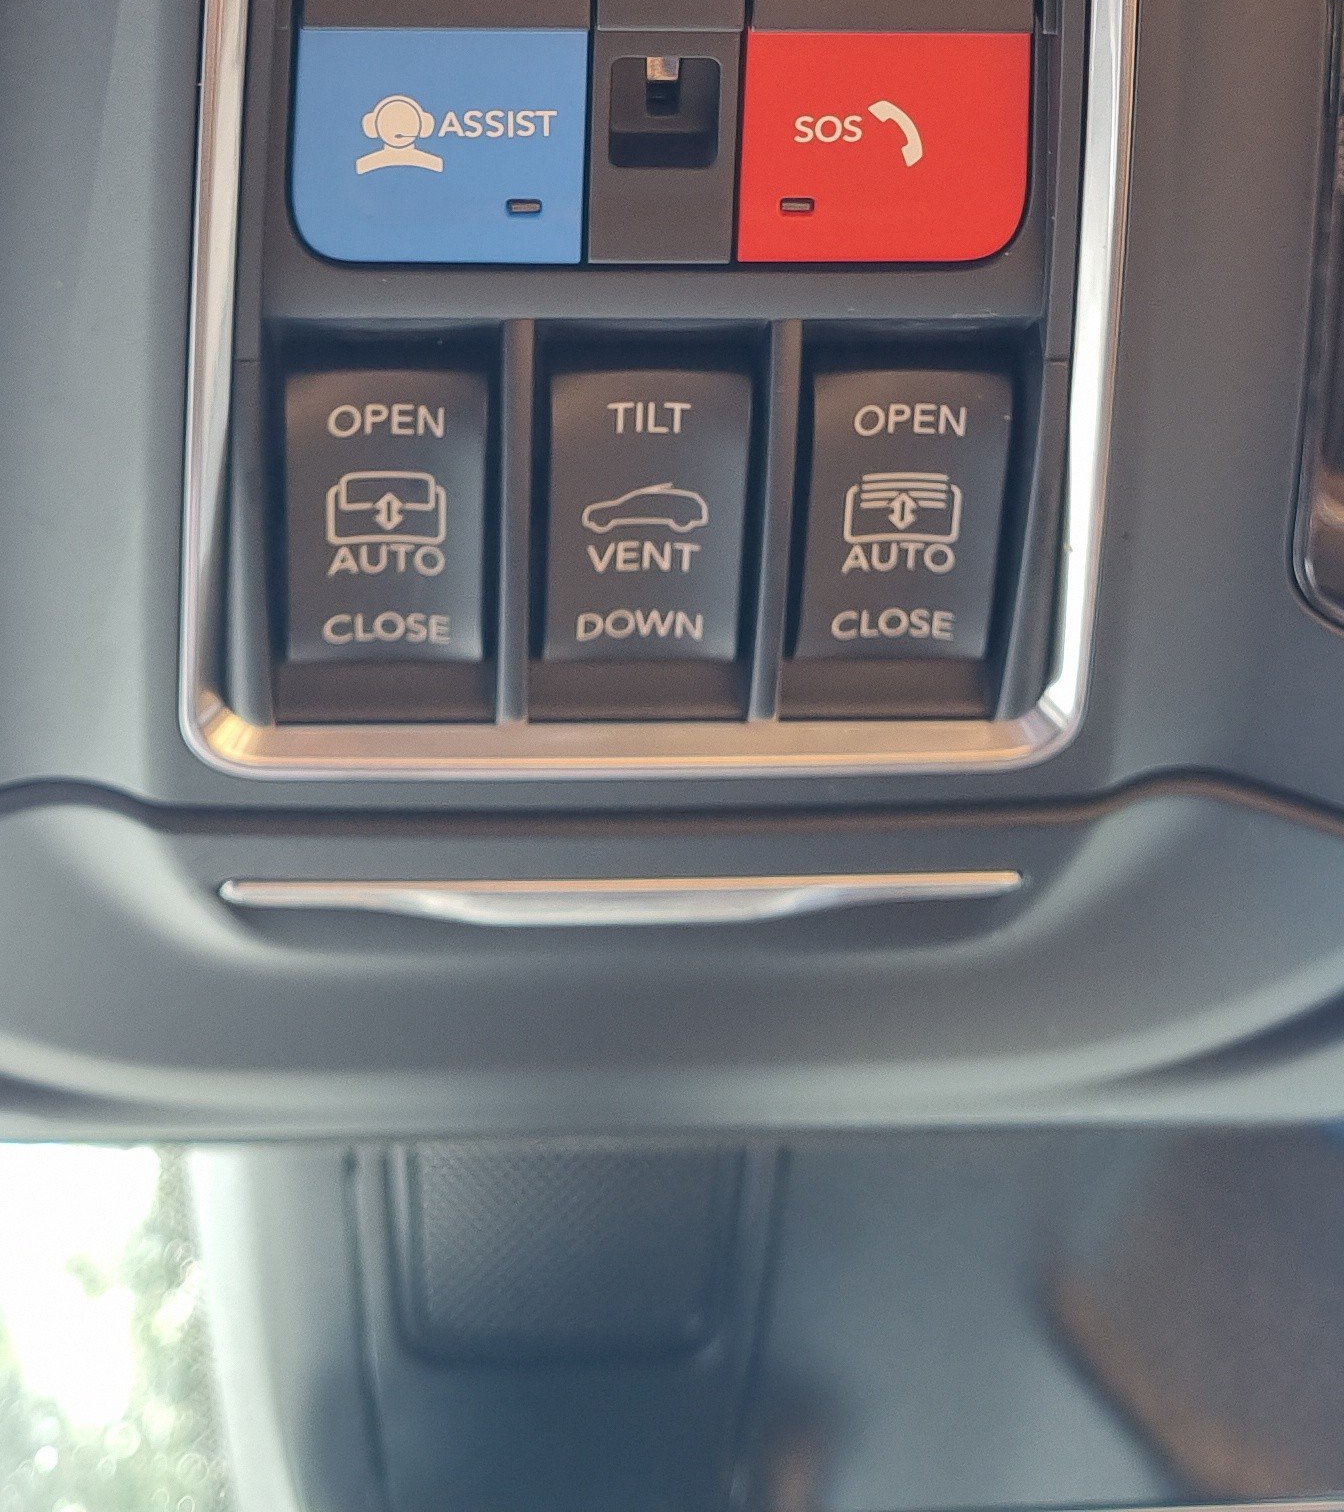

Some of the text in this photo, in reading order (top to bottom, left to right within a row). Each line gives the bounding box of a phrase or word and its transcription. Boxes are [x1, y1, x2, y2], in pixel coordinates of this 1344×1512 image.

[437, 110, 558, 138] ASSIST
[793, 114, 863, 143] SOS
[327, 403, 445, 439] OPEN
[606, 401, 692, 434] TILT
[853, 402, 967, 437] OPEN
[327, 544, 447, 577] AUTO
[587, 540, 701, 573] VENT
[841, 543, 956, 574] AUTO
[323, 612, 451, 645] CLOSE
[575, 609, 704, 643] DOWN
[831, 607, 956, 642] CLOSE
